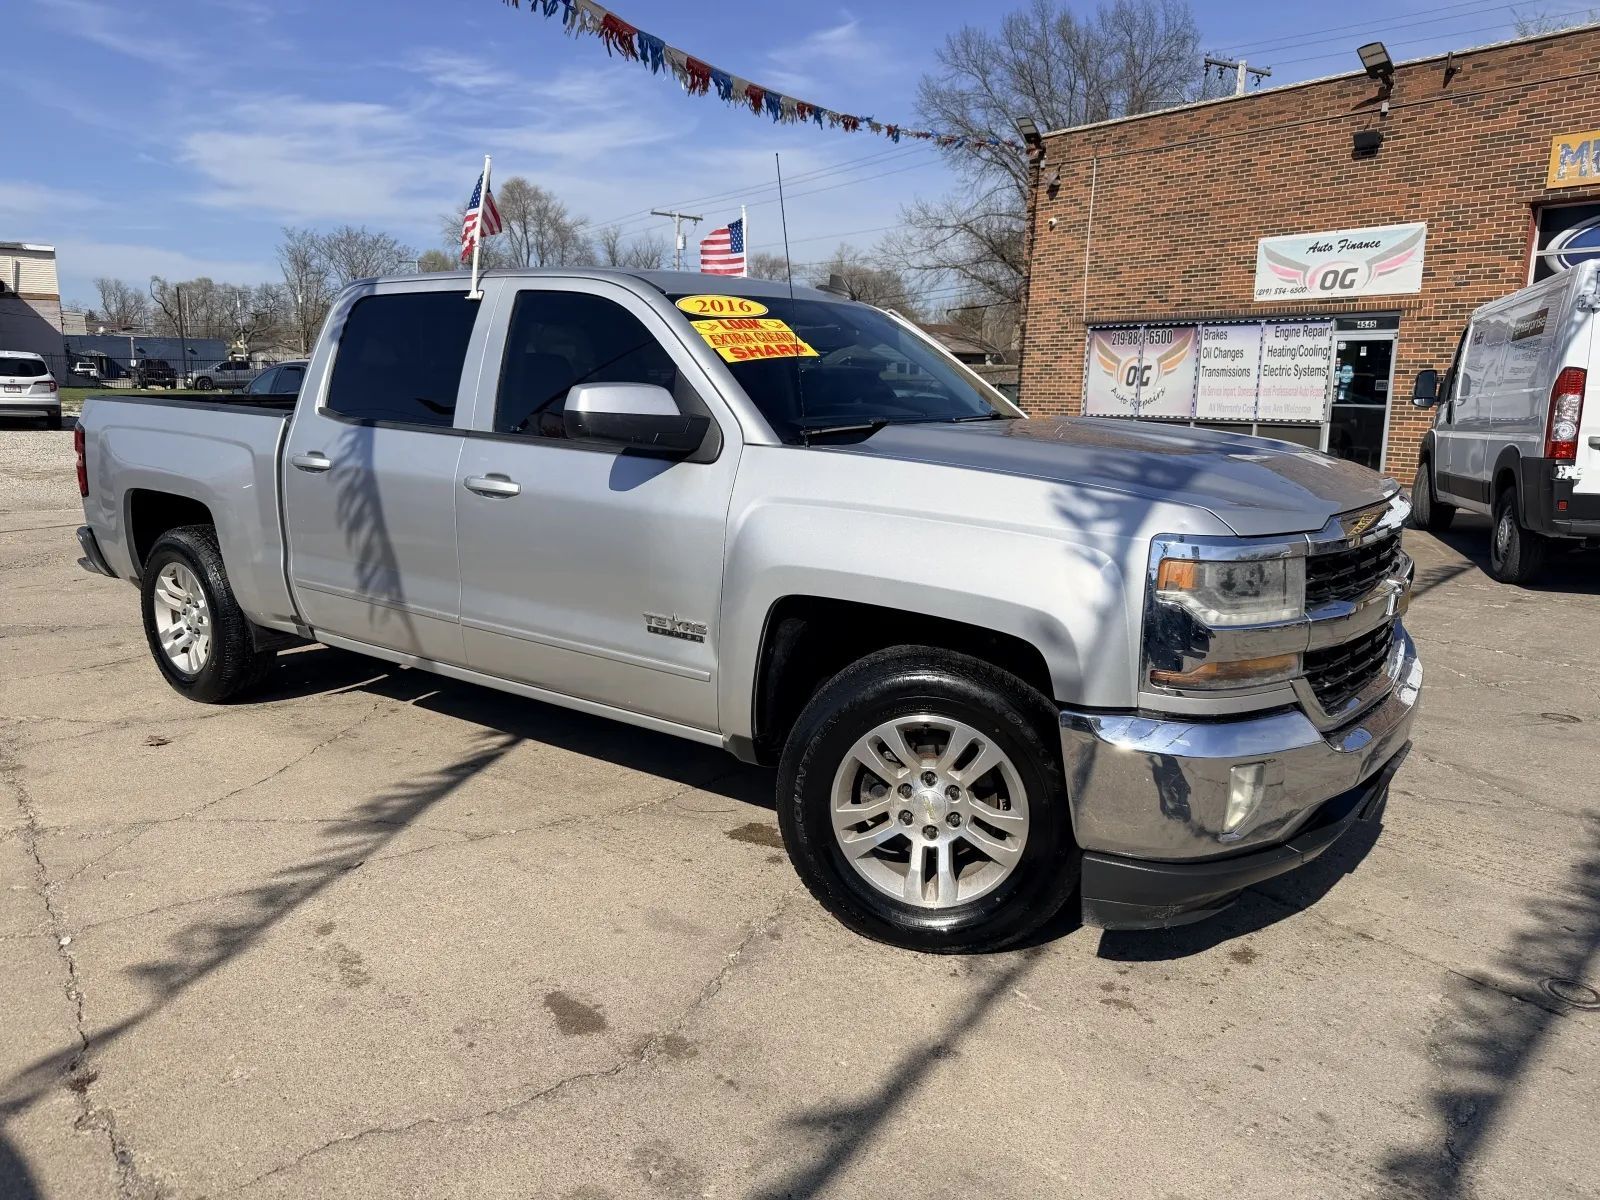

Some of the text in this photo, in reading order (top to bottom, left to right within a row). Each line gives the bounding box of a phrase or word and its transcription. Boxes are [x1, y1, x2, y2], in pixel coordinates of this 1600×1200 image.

[1306, 238, 1382, 254] Auto Finance
[1319, 267, 1359, 291] OG
[694, 299, 752, 313] 2016
[718, 319, 762, 331] LOOK
[1275, 324, 1329, 341] Engine Repair
[1357, 320, 1377, 329] 4545
[709, 331, 794, 346] EXTRA CLEAN
[1203, 328, 1228, 341] Brakes
[729, 343, 807, 360] SHARP
[1202, 346, 1244, 362] Oil Changes
[1267, 344, 1328, 360] Heating/Cooling
[1125, 364, 1152, 387] OG
[1201, 365, 1251, 378] Transmissions
[1263, 363, 1326, 379] Electric Systems
[1111, 387, 1128, 405] Auto
